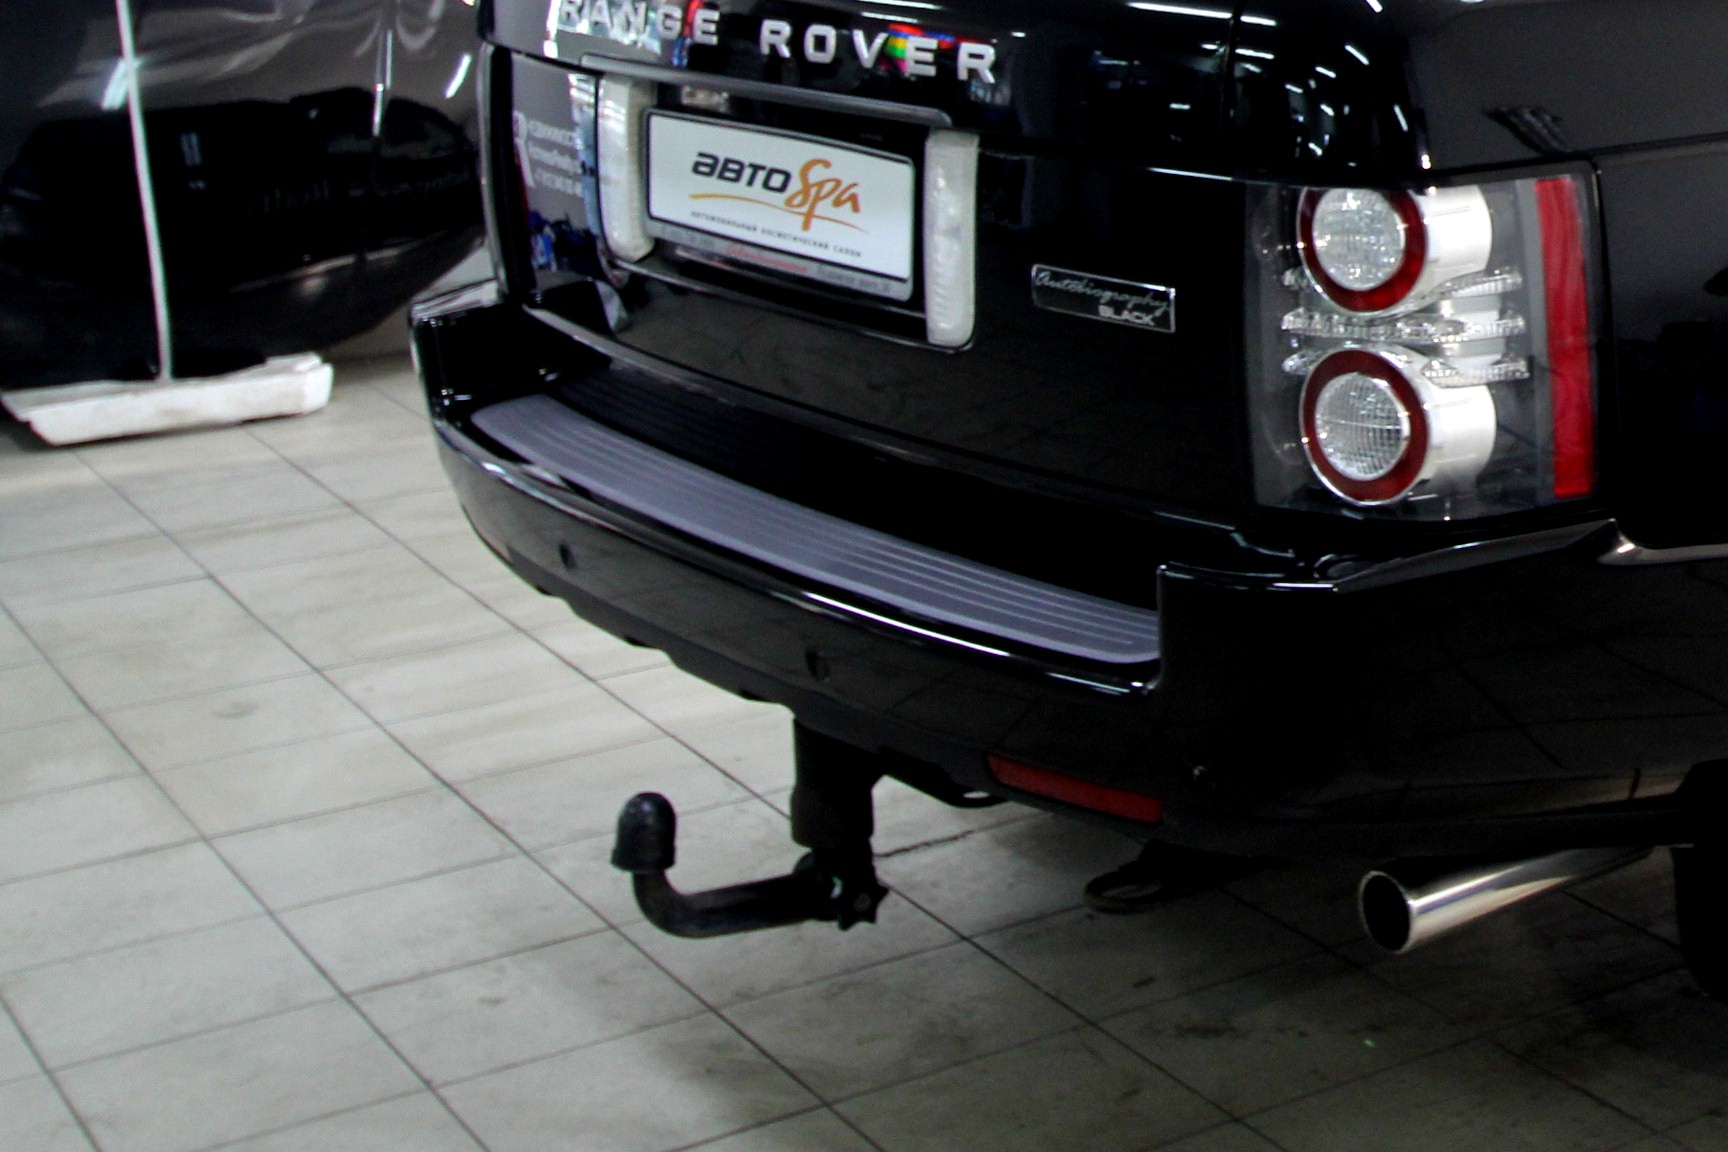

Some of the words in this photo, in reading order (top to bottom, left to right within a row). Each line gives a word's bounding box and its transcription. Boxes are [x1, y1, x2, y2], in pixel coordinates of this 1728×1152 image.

[759, 18, 997, 84] ROVER
[1035, 270, 1168, 318] Autobiography
[1097, 304, 1156, 327] BLACK
